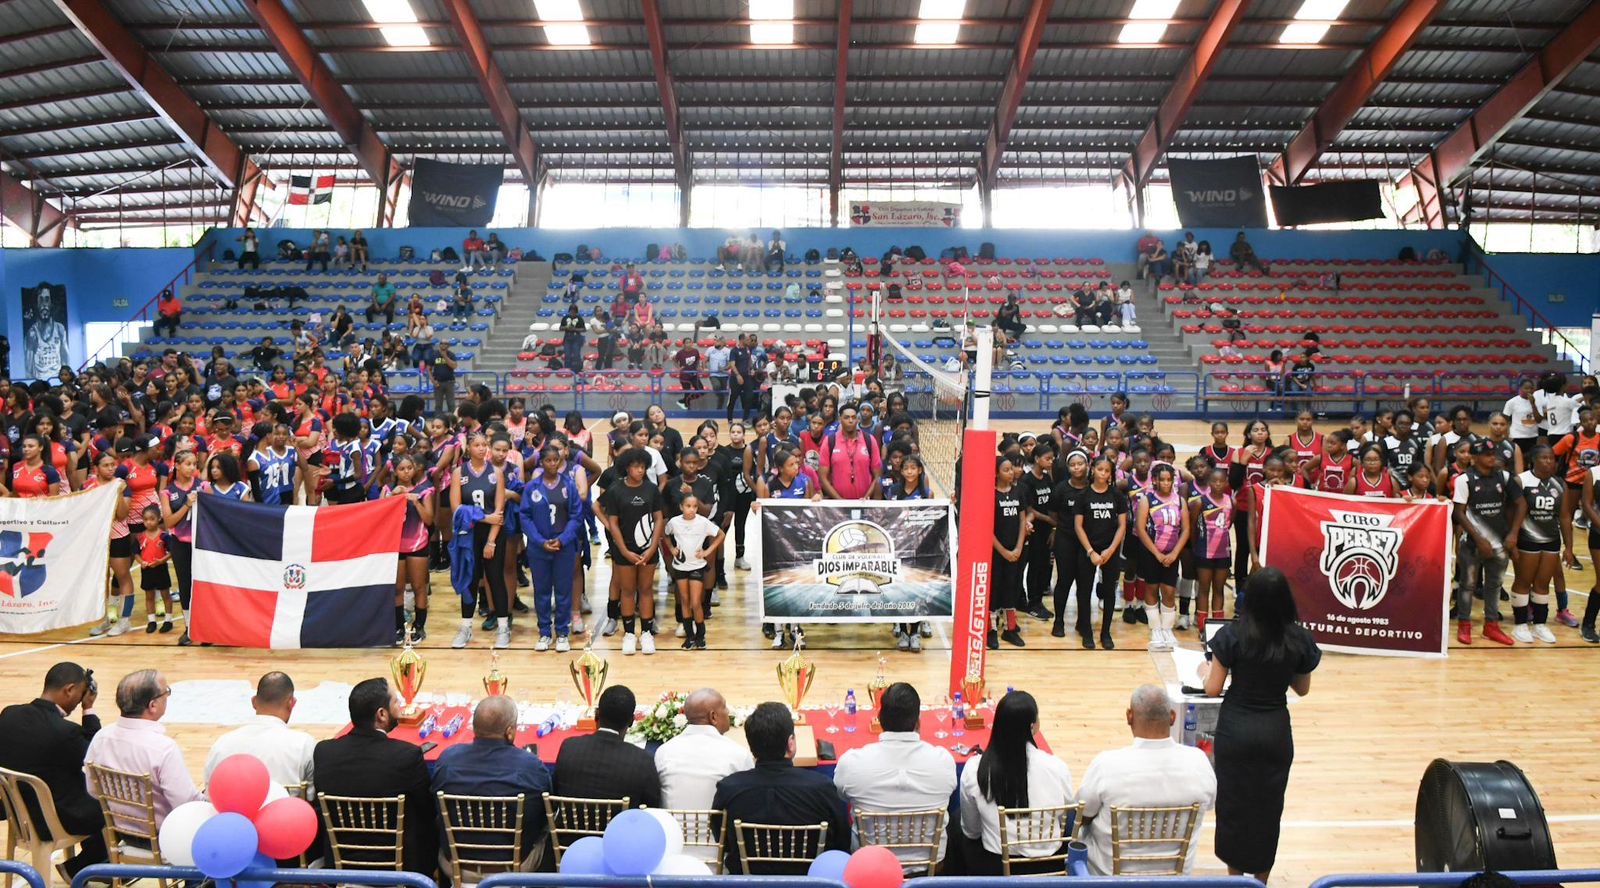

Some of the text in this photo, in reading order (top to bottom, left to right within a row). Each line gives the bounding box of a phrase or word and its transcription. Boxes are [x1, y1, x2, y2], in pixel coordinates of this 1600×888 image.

[1550, 412, 1557, 426] 8
[1398, 453, 1413, 464] 08
[1535, 495, 1555, 510] 02
[1003, 507, 1018, 517] EVA
[1093, 509, 1111, 519] EVA
[1161, 508, 1177, 526] 11
[1215, 512, 1225, 529] 4
[1342, 513, 1381, 527] CIRO
[1328, 526, 1397, 560] PEREZ
[817, 561, 841, 576] DIOS
[842, 560, 898, 576] IMPARABLE
[1326, 613, 1389, 625] 16 de agosto 1983
[1294, 620, 1423, 640] LTURAL DEPORTIVO
